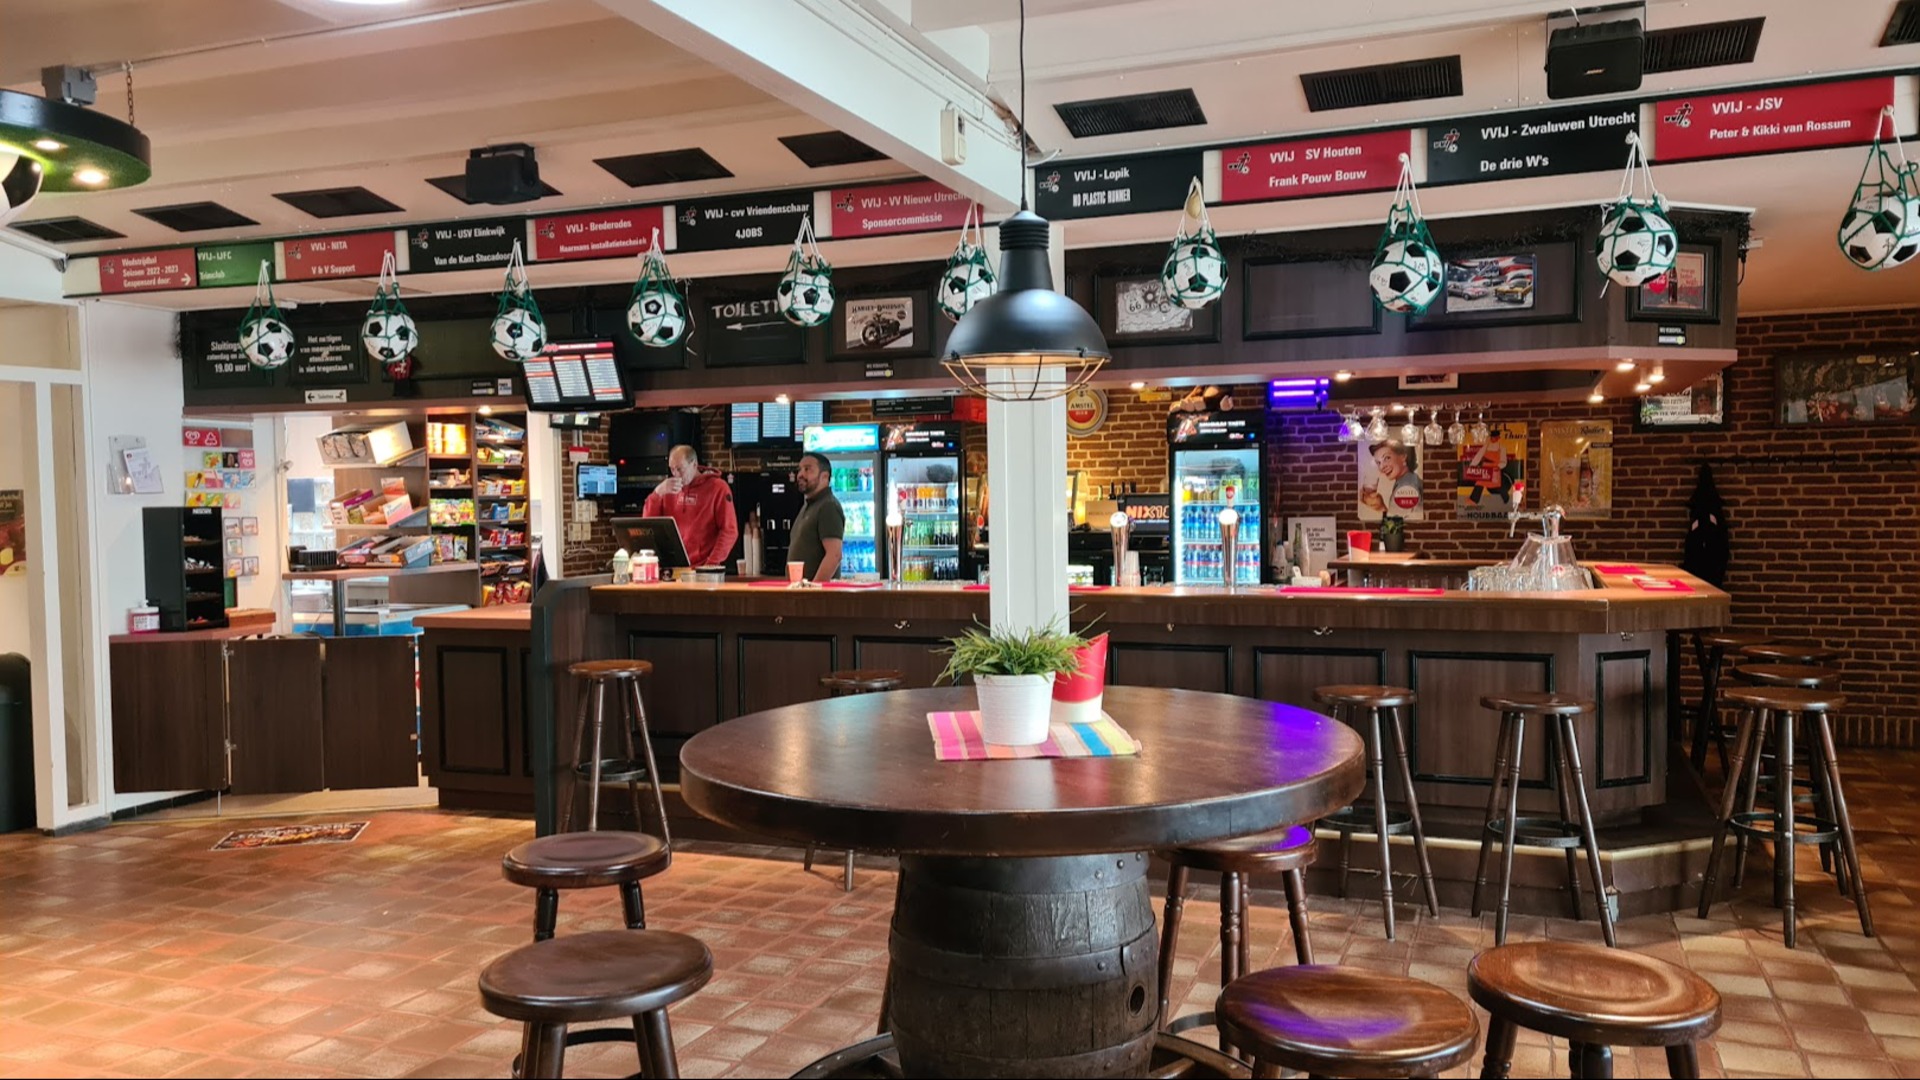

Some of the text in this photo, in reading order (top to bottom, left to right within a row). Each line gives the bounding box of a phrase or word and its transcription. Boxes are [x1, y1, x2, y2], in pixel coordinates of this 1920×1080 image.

[1712, 100, 1743, 115] VVIJ
[1755, 97, 1783, 113] JSV
[1481, 126, 1509, 141] VVIJ
[1520, 119, 1585, 137] Zwaluwen
[1588, 110, 1636, 128] Utrecht
[1709, 118, 1851, 140] Peter & Kikki van Rossum
[1270, 146, 1362, 164] VVIJ SV Houten
[1480, 154, 1550, 173] De drie W's
[1073, 169, 1097, 182] VVIJ
[1269, 169, 1367, 188] Frank Pouw Bouw
[861, 197, 881, 209] VVIJ
[889, 195, 902, 207] VV
[903, 193, 932, 205] Nieuw
[1082, 190, 1106, 206] PLASTIC
[704, 208, 724, 219] VVIJ
[730, 209, 745, 218] cvv
[746, 203, 810, 216] Vriendenschaar
[566, 223, 584, 234] VVIJ
[590, 219, 632, 231] Brederodes
[862, 212, 943, 230] Sponsorcommissie
[435, 229, 452, 239] VVIJ
[457, 228, 473, 239] USV
[474, 226, 506, 237] Elinkwijk
[735, 227, 763, 239] 4JOBS
[310, 242, 326, 252] VVIJ
[331, 241, 348, 250] NITA
[434, 256, 448, 266] Van
[448, 255, 458, 264] de
[459, 254, 475, 264] Kant
[122, 268, 145, 278] Seizoen
[147, 267, 160, 276] 2022
[165, 265, 178, 274] 2023
[311, 266, 317, 275] V
[324, 265, 330, 274] V
[331, 264, 356, 274] Support
[214, 362, 234, 373] 19.00
[1070, 402, 1095, 410] AMSTEL
[1466, 467, 1489, 475] AMSTEL
